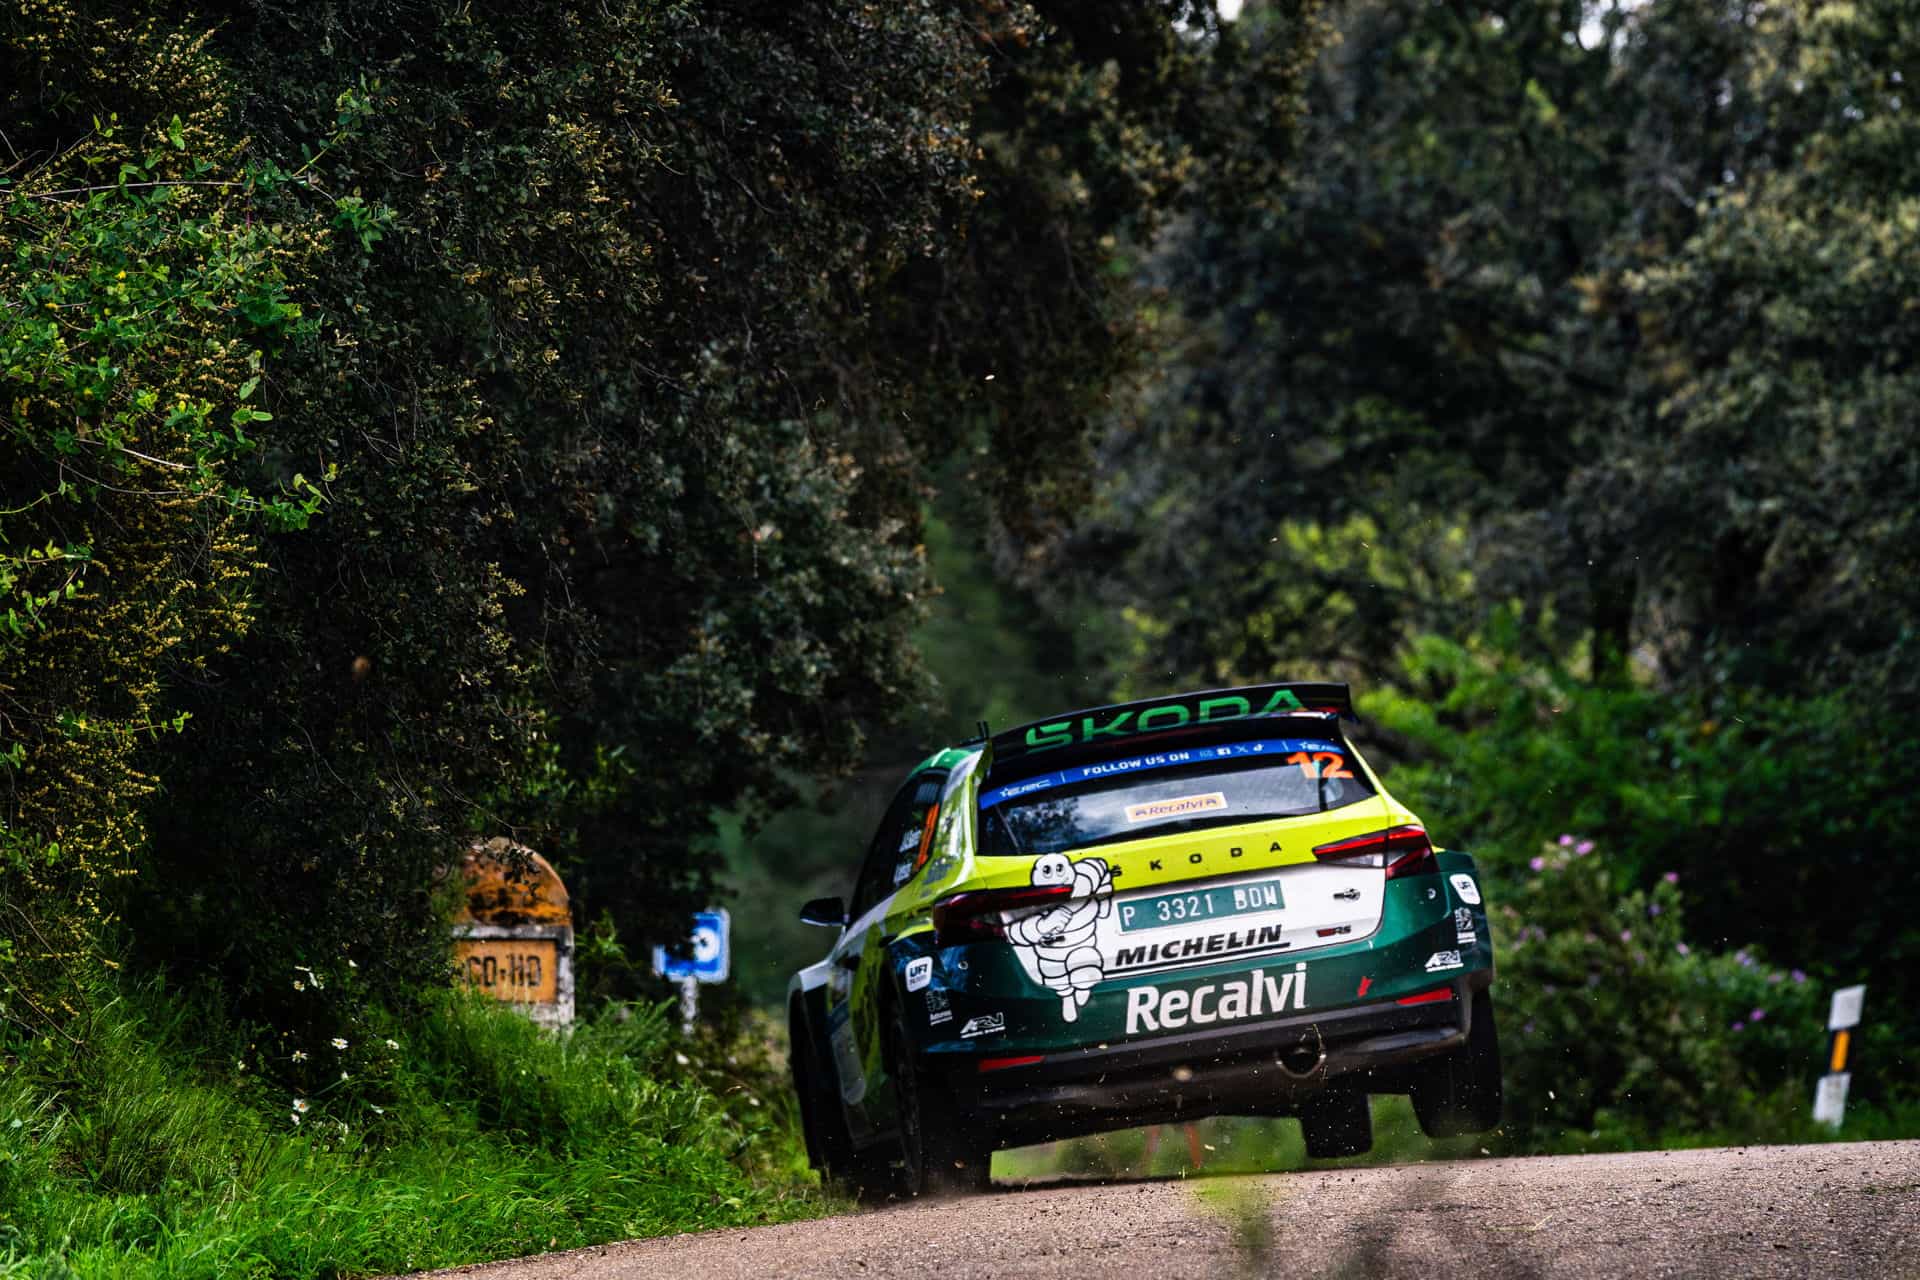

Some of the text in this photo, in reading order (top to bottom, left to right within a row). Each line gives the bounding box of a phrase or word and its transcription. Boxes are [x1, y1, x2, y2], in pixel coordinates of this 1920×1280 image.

[1082, 759, 1141, 776] FOLLOW
[1145, 755, 1165, 765] US
[1169, 752, 1189, 761] ON
[1286, 751, 1354, 779] 12
[1122, 905, 1135, 926] P
[1157, 894, 1214, 921] 3321
[1116, 924, 1282, 967] MICHELIN
[1125, 962, 1307, 1034] Recalvi
